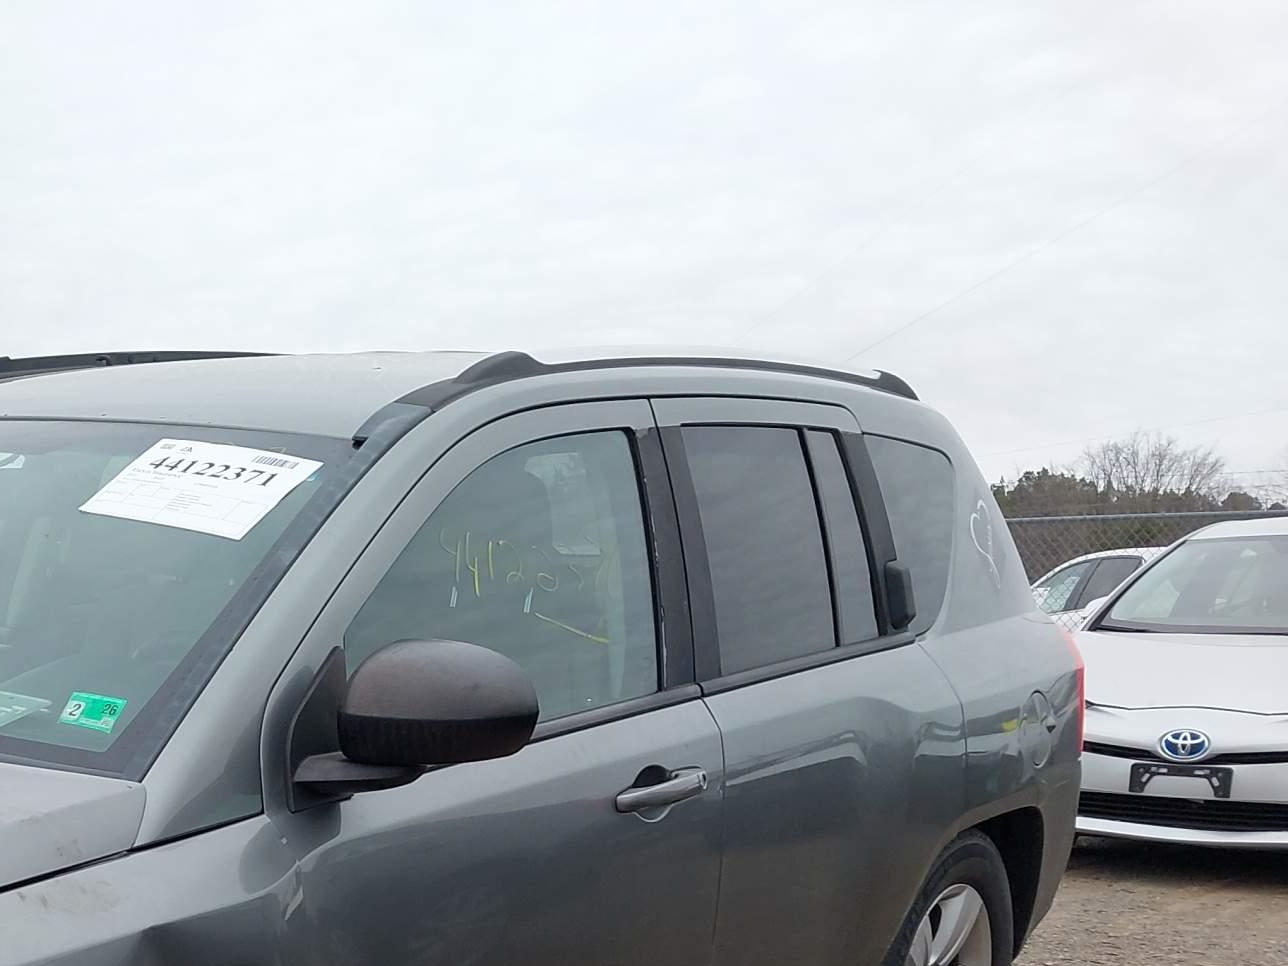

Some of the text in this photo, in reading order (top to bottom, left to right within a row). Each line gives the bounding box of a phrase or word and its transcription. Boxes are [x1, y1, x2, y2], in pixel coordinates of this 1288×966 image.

[149, 456, 278, 487] 44122371
[69, 703, 82, 717] 2
[101, 703, 119, 716] 26
